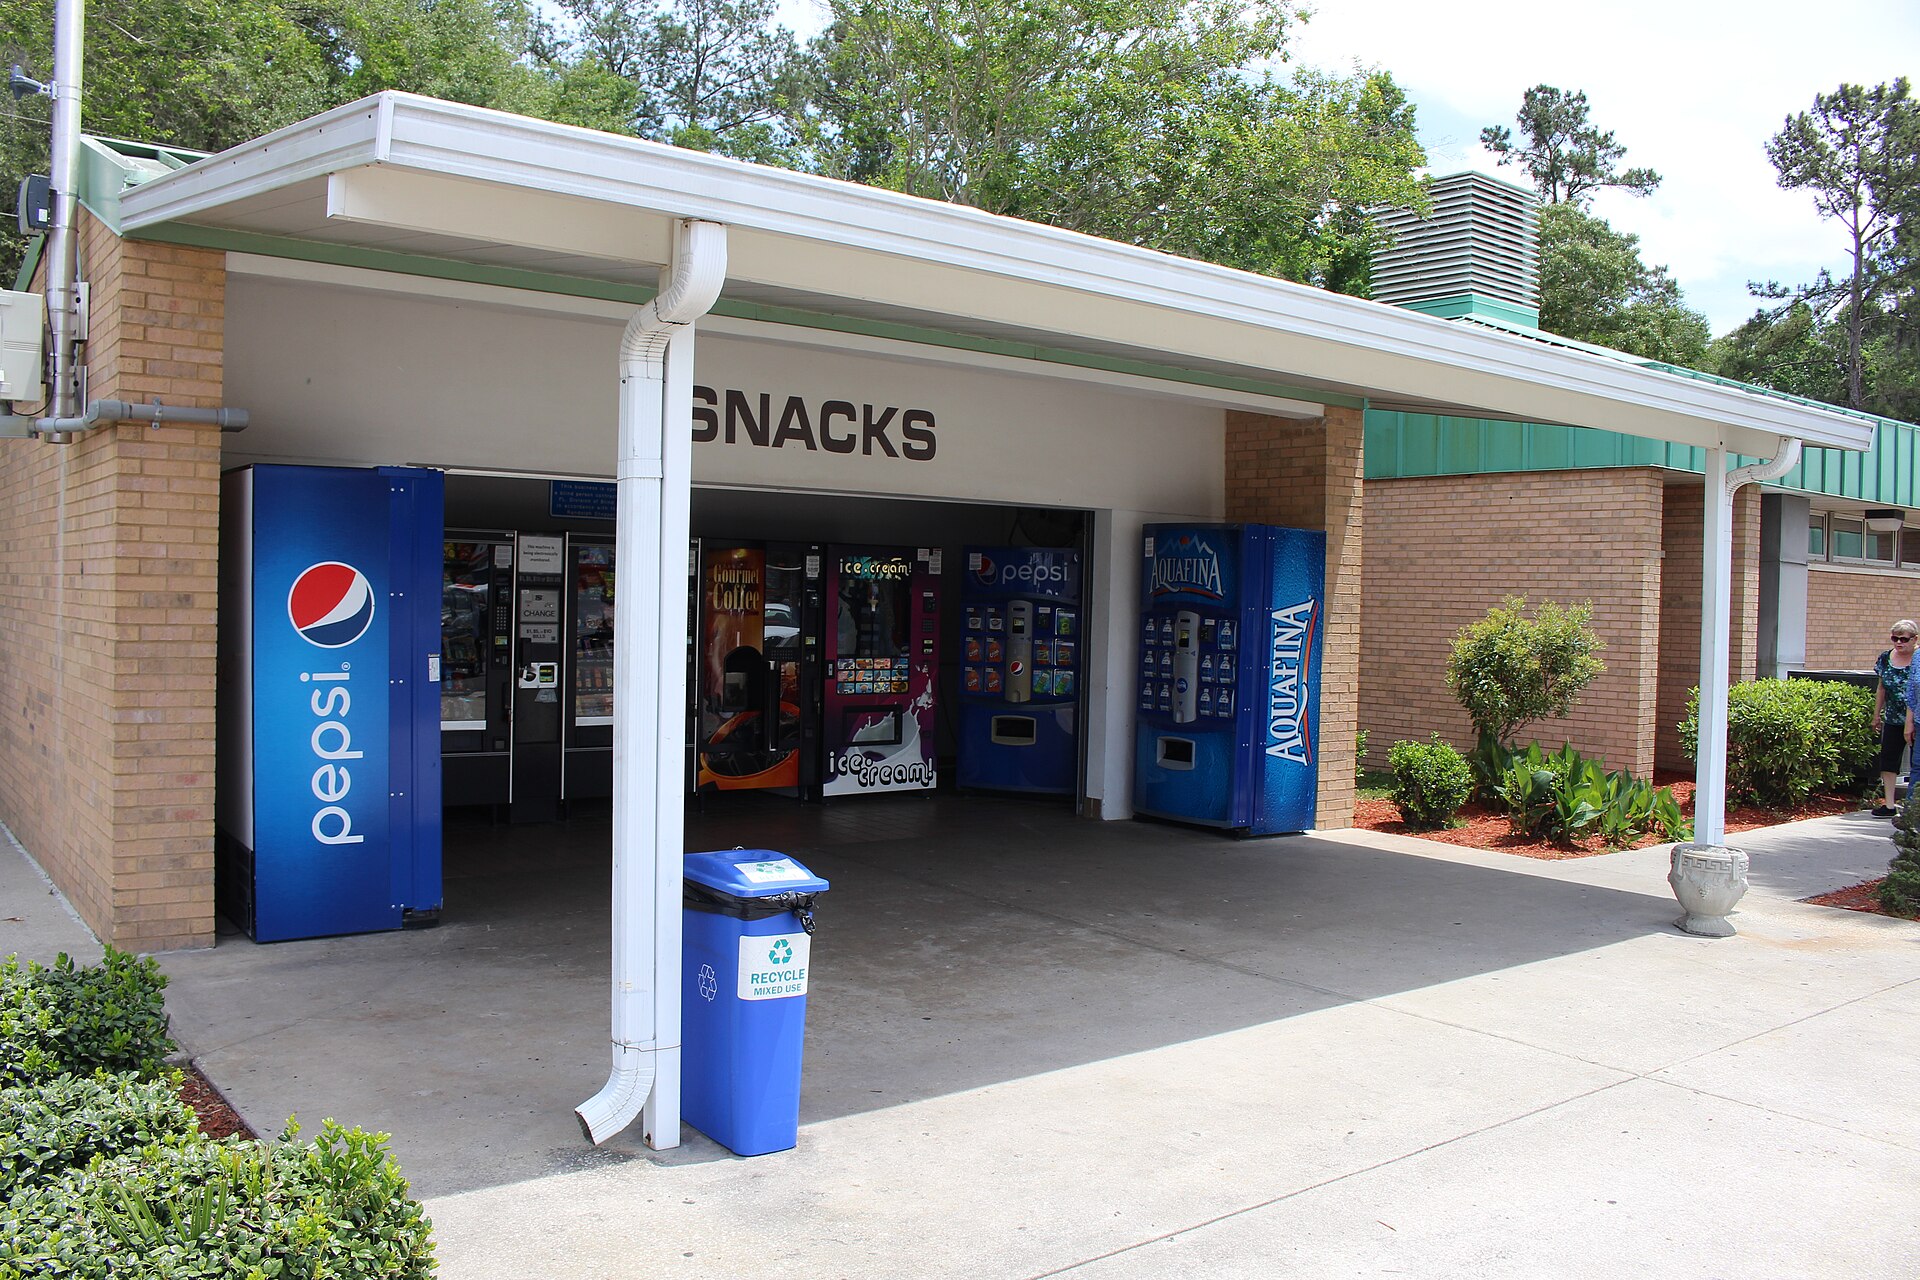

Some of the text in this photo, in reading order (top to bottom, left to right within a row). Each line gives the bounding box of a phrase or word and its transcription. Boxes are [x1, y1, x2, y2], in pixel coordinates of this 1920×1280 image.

[692, 385, 936, 461] SNACKS
[713, 564, 759, 584] Gourmet
[840, 558, 861, 573] ice
[1002, 562, 1068, 585] pepsi
[1149, 551, 1223, 597] AQUAFINA
[713, 583, 759, 610] Coffee
[523, 609, 556, 618] CHANGE
[1265, 598, 1315, 766] AQUAFINA
[300, 671, 364, 845] pepsi
[829, 751, 863, 776] ice
[858, 757, 933, 787] cream!
[751, 968, 805, 984] RECYCLE
[754, 983, 802, 996] MIXED USE
